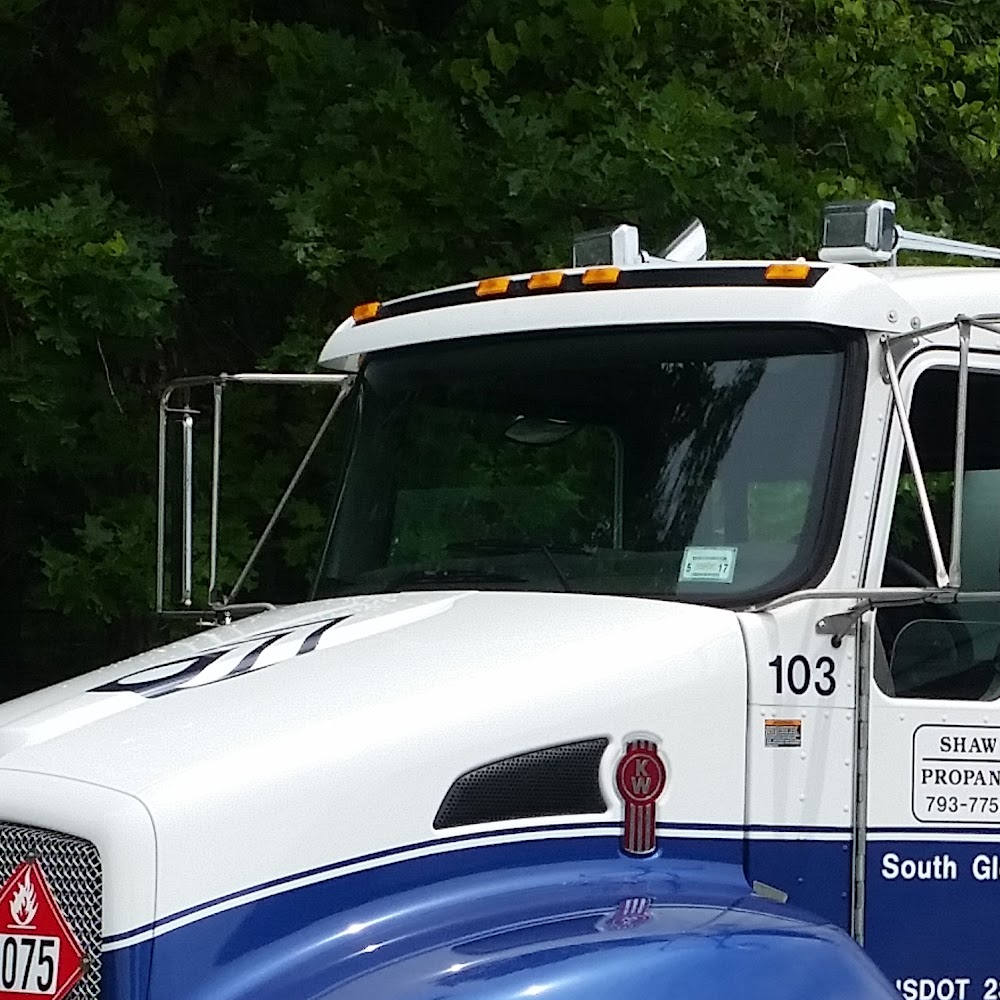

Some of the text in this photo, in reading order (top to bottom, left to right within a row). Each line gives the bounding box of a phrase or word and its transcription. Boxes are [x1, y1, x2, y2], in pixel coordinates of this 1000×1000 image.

[769, 655, 836, 697] 103
[940, 736, 997, 754] SHAW
[634, 758, 649, 777] K
[631, 777, 652, 795] W
[881, 853, 957, 880] South
[0, 936, 56, 993] 075
